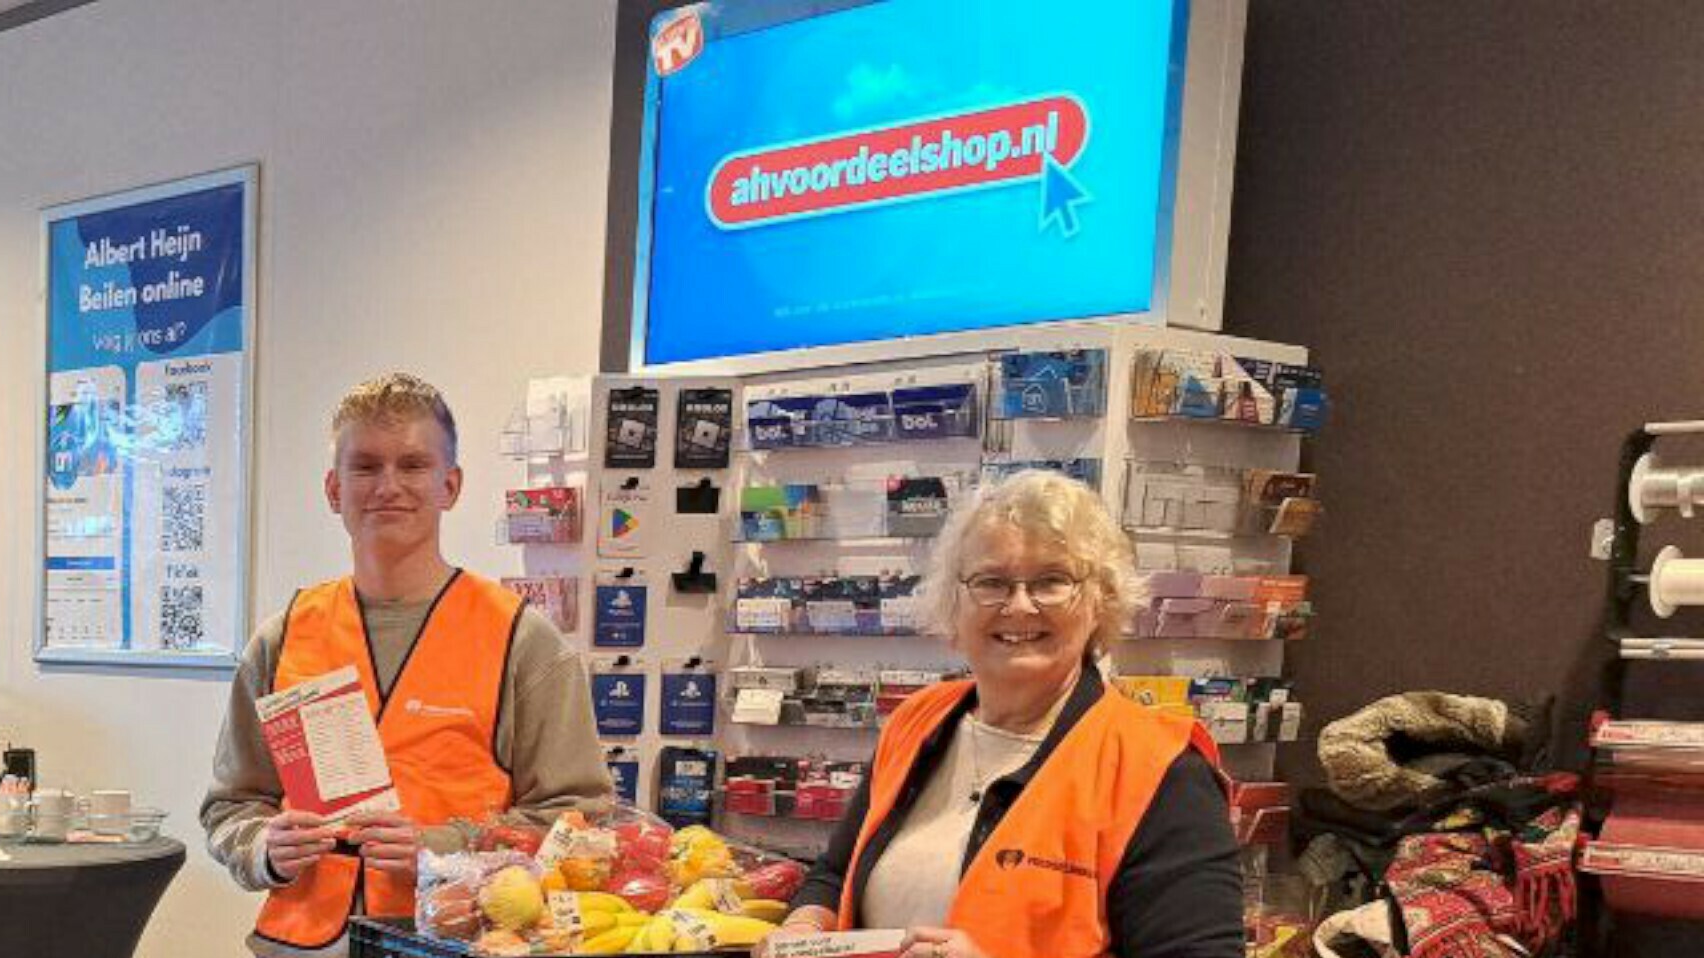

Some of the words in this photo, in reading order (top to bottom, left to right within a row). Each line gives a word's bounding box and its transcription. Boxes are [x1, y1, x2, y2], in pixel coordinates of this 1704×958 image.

[730, 111, 1059, 206] ahvoordeelshop.nl
[84, 236, 145, 269] Albert
[150, 225, 202, 262] Heijn
[79, 281, 137, 312] Beilen
[141, 271, 204, 304] online
[138, 329, 162, 345] ons
